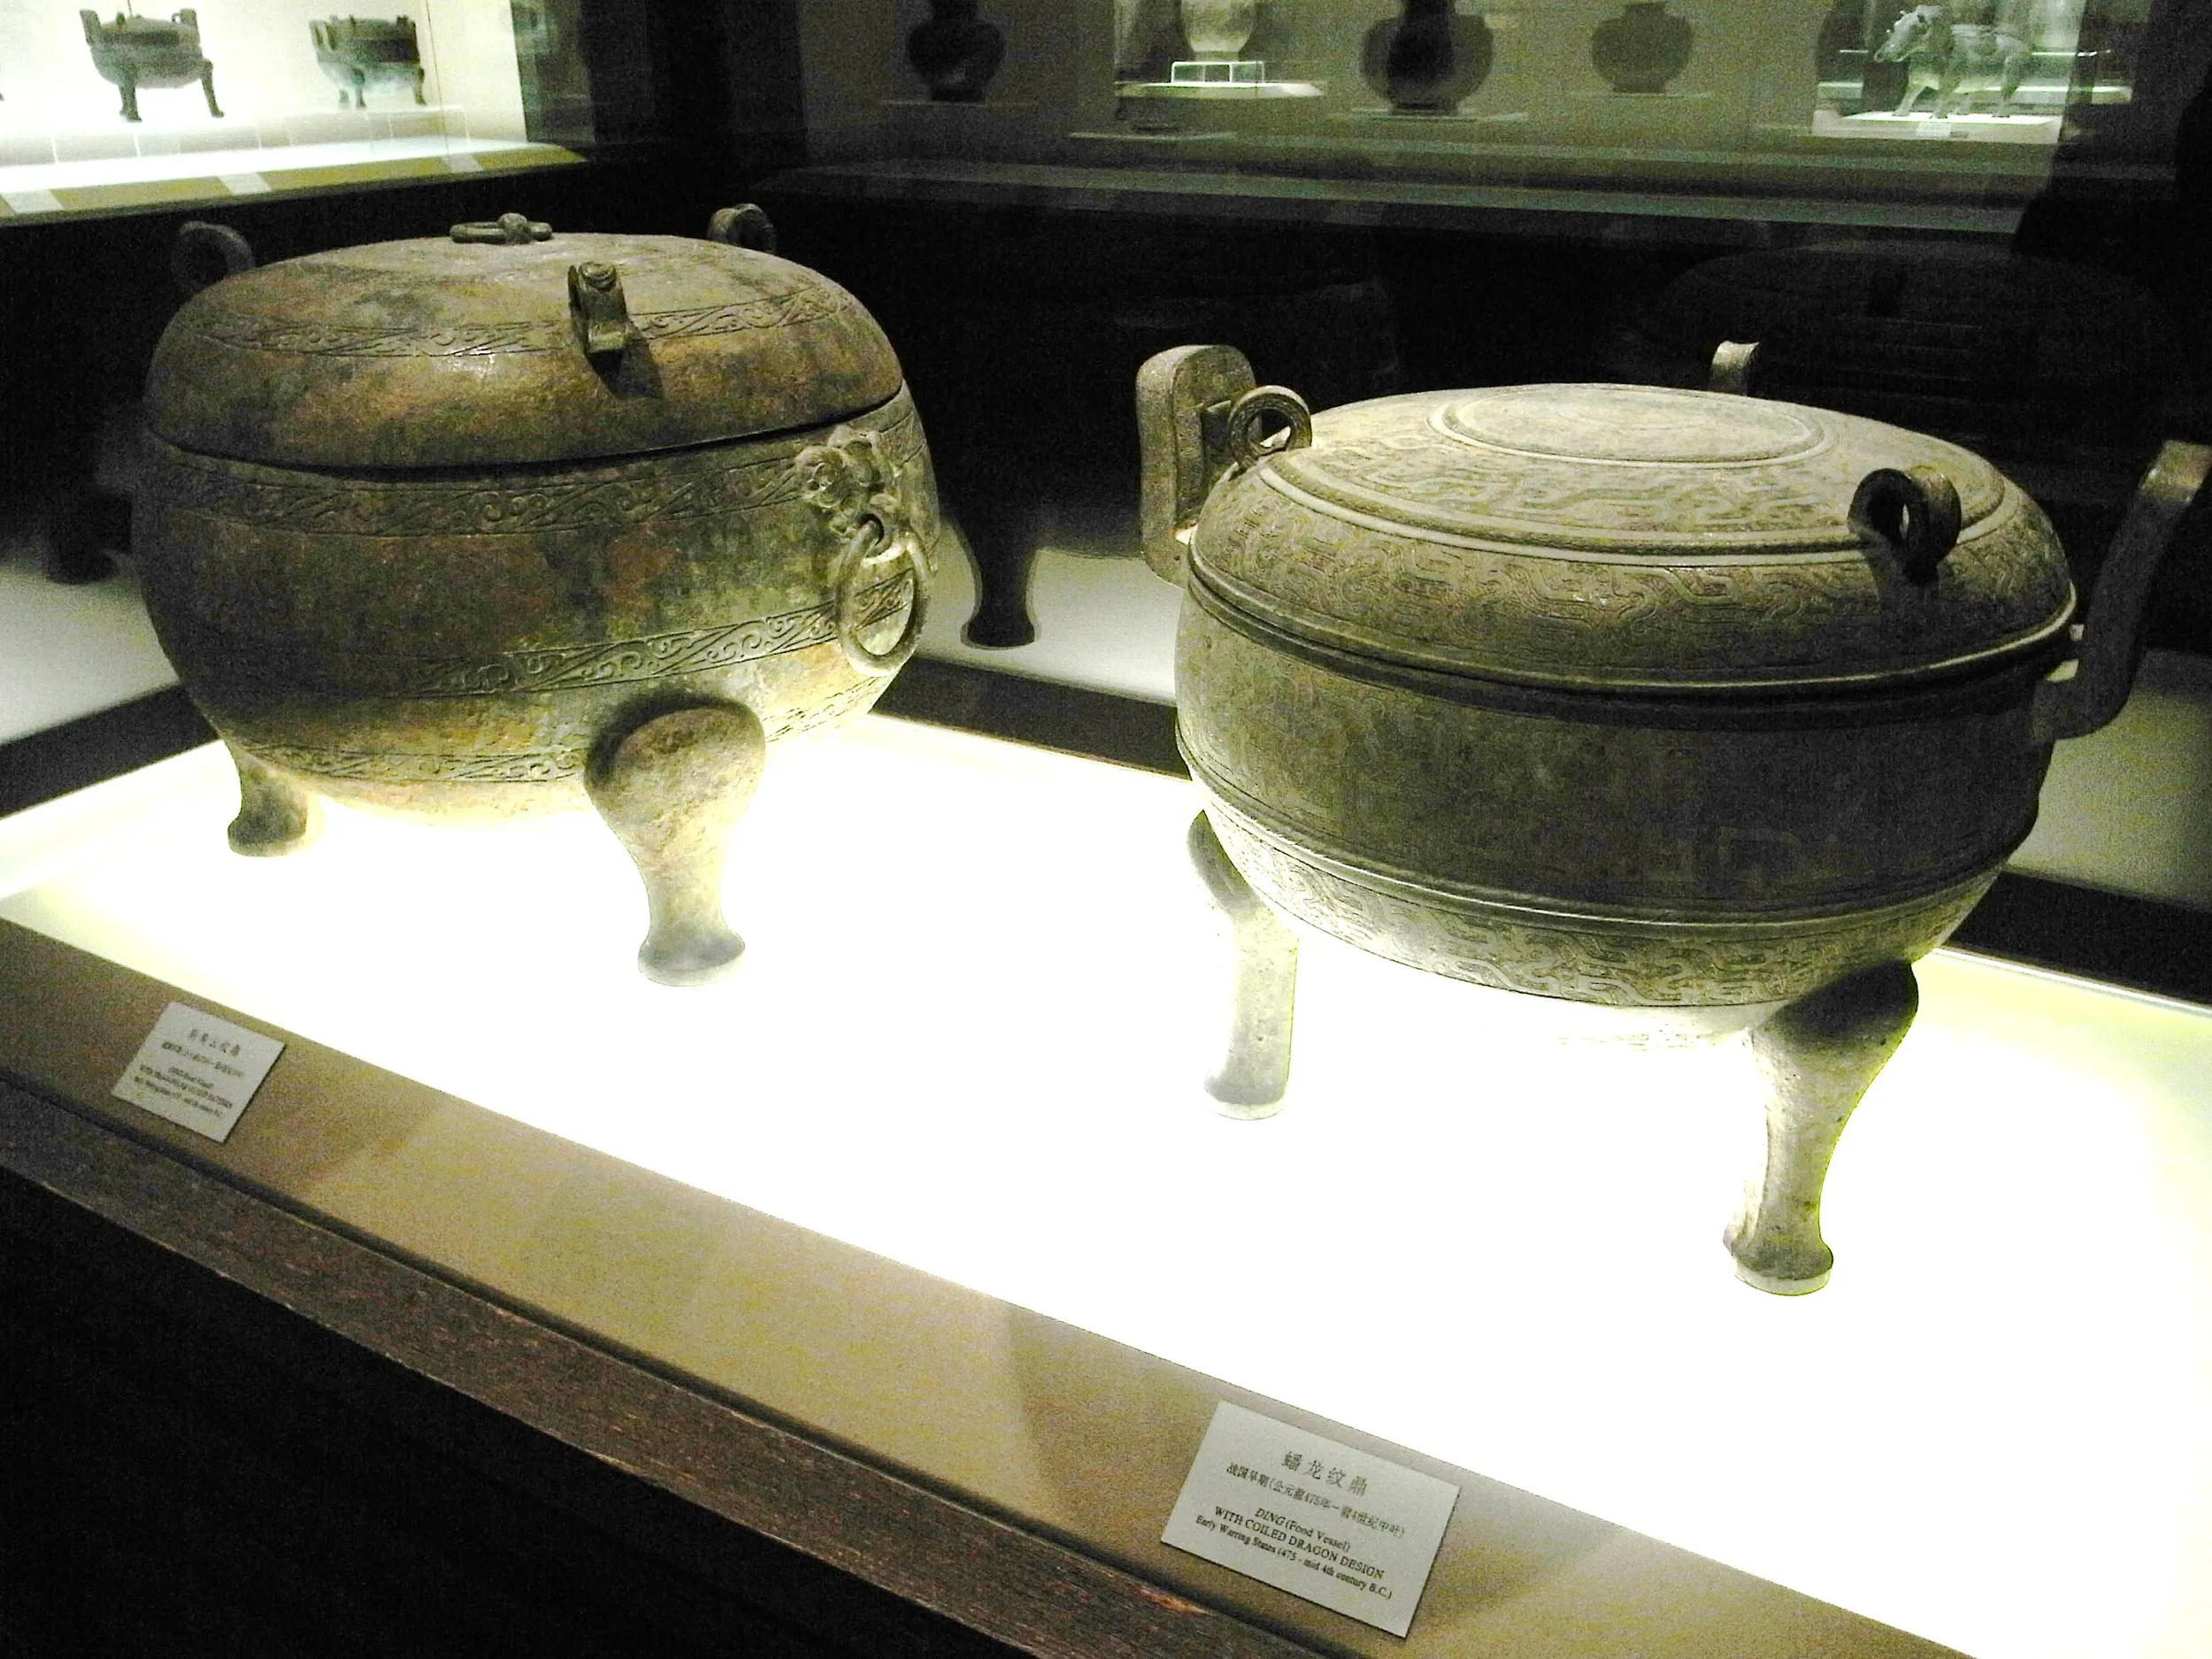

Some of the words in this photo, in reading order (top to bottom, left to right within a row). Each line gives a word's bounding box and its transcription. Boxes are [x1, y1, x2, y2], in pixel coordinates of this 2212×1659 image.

[1281, 1450, 1368, 1497] 蟠龙纹鼎
[1195, 1515, 1217, 1532] Early
[1219, 1524, 1250, 1546] Warring
[1252, 1534, 1276, 1553] States
[1277, 1547, 1296, 1562] (475
[1322, 1564, 1334, 1578] 4th
[1336, 1570, 1367, 1591] century
[1368, 1581, 1393, 1600] B.C.)
[1215, 1506, 1242, 1525] WITH
[1245, 1519, 1286, 1541] COILED
[1288, 1536, 1337, 1562] DRAGON
[1340, 1556, 1385, 1579] DESIGN
[1255, 1508, 1286, 1526] DING
[1286, 1519, 1314, 1538] (Food
[1317, 1531, 1350, 1552] Vessel)
